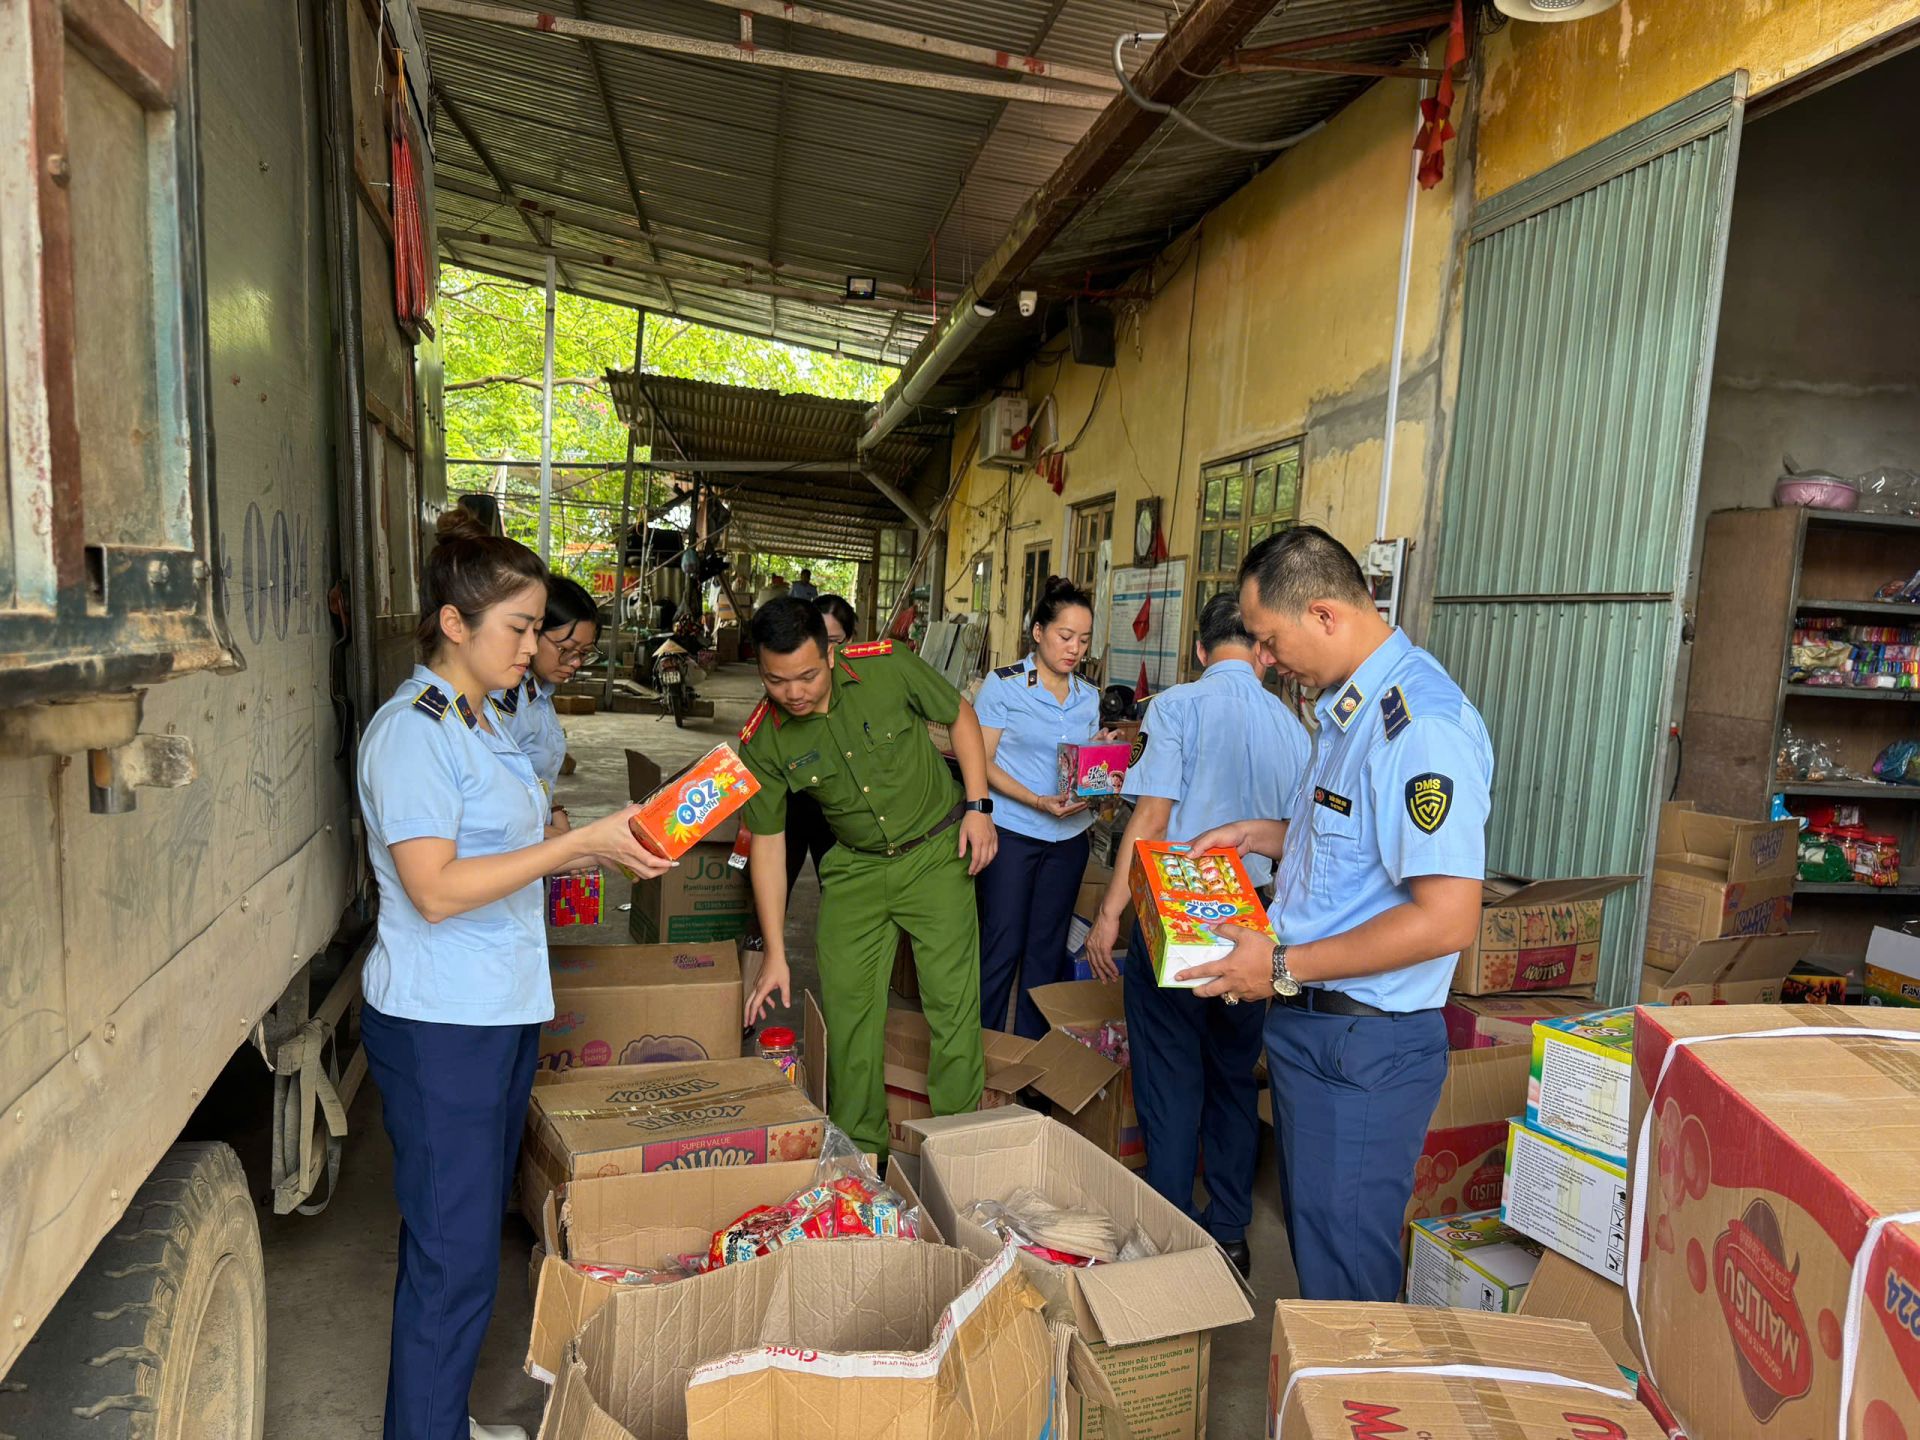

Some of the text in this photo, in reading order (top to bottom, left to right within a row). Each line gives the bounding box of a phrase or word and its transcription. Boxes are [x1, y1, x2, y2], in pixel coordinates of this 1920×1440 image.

[1415, 778, 1441, 792] DMS
[677, 778, 720, 825] ZOO
[697, 799, 718, 822] HAPPY
[1185, 903, 1237, 919] ZOO
[1192, 899, 1219, 908] HAPPY
[1521, 961, 1566, 981] BALLOON
[606, 1078, 719, 1103] BALLOON
[627, 1105, 746, 1130] BALLOON
[681, 1136, 731, 1150] SUPER VALUE
[1723, 1258, 1800, 1377] MAILISU
[1108, 1362, 1117, 1370] TY
[1150, 1361, 1166, 1370] LONG
[1750, 1335, 1783, 1381] CHOCOLATE
